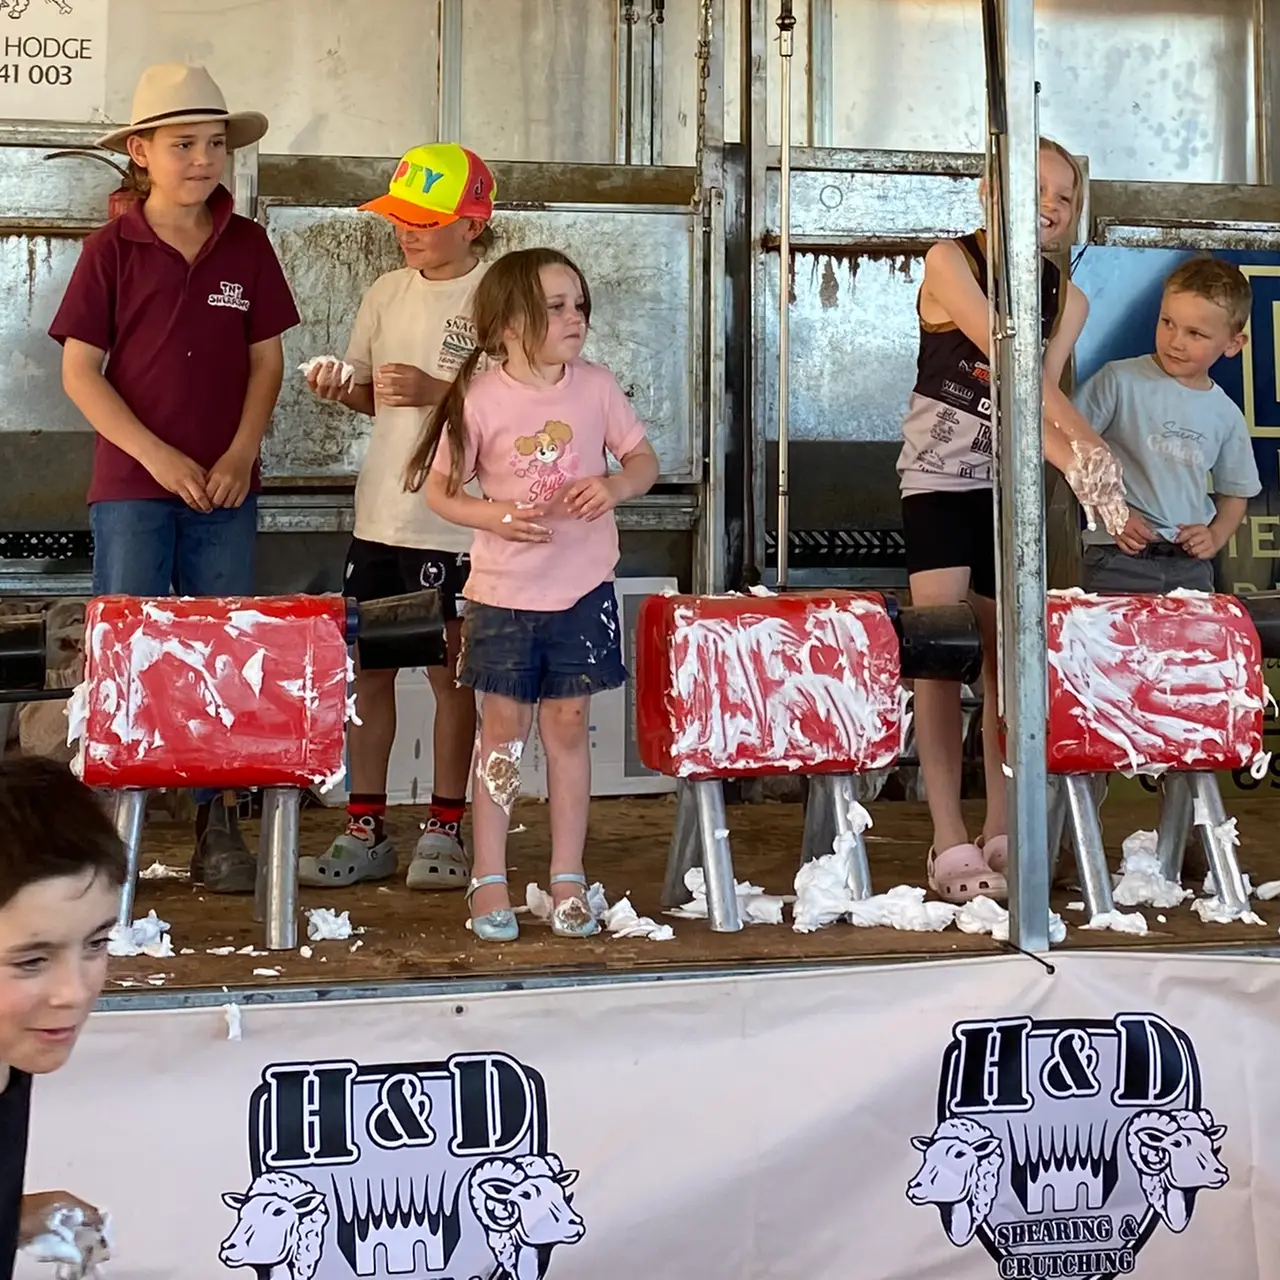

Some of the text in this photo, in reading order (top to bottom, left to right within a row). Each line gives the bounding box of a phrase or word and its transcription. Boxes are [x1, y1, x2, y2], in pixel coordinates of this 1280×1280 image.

[5, 36, 92, 59] HODGE
[28, 65, 72, 85] 003
[393, 160, 445, 194] PTY
[220, 281, 243, 299] TNT
[995, 1215, 1140, 1248] SHEARING &
[999, 1248, 1135, 1280] CRUTCHING
